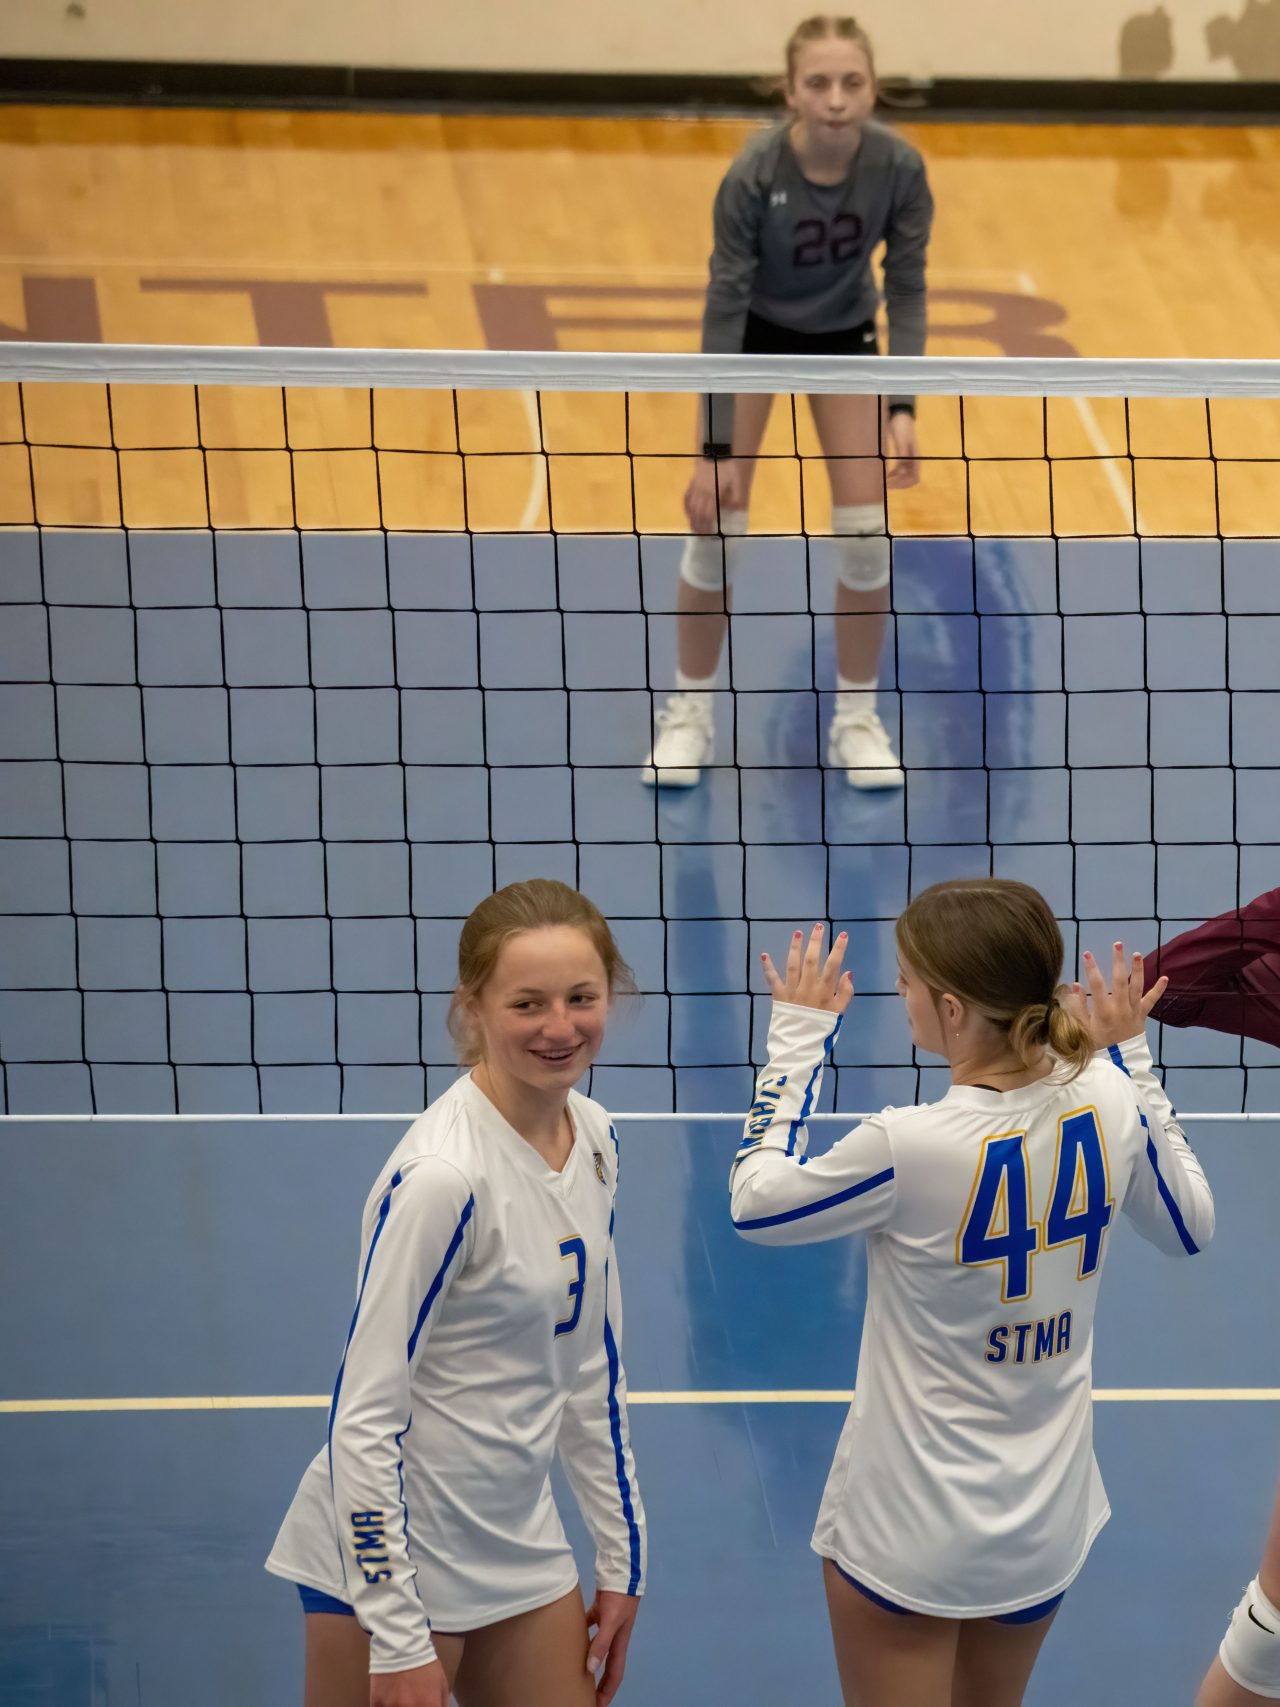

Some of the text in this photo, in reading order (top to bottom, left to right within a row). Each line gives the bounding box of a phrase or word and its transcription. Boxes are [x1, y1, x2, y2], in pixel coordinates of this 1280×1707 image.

[793, 214, 863, 268] 22
[955, 1104, 1116, 1304] 44
[553, 1233, 588, 1340] 3
[984, 1308, 1073, 1365] STMA
[350, 1510, 393, 1585] STMA
